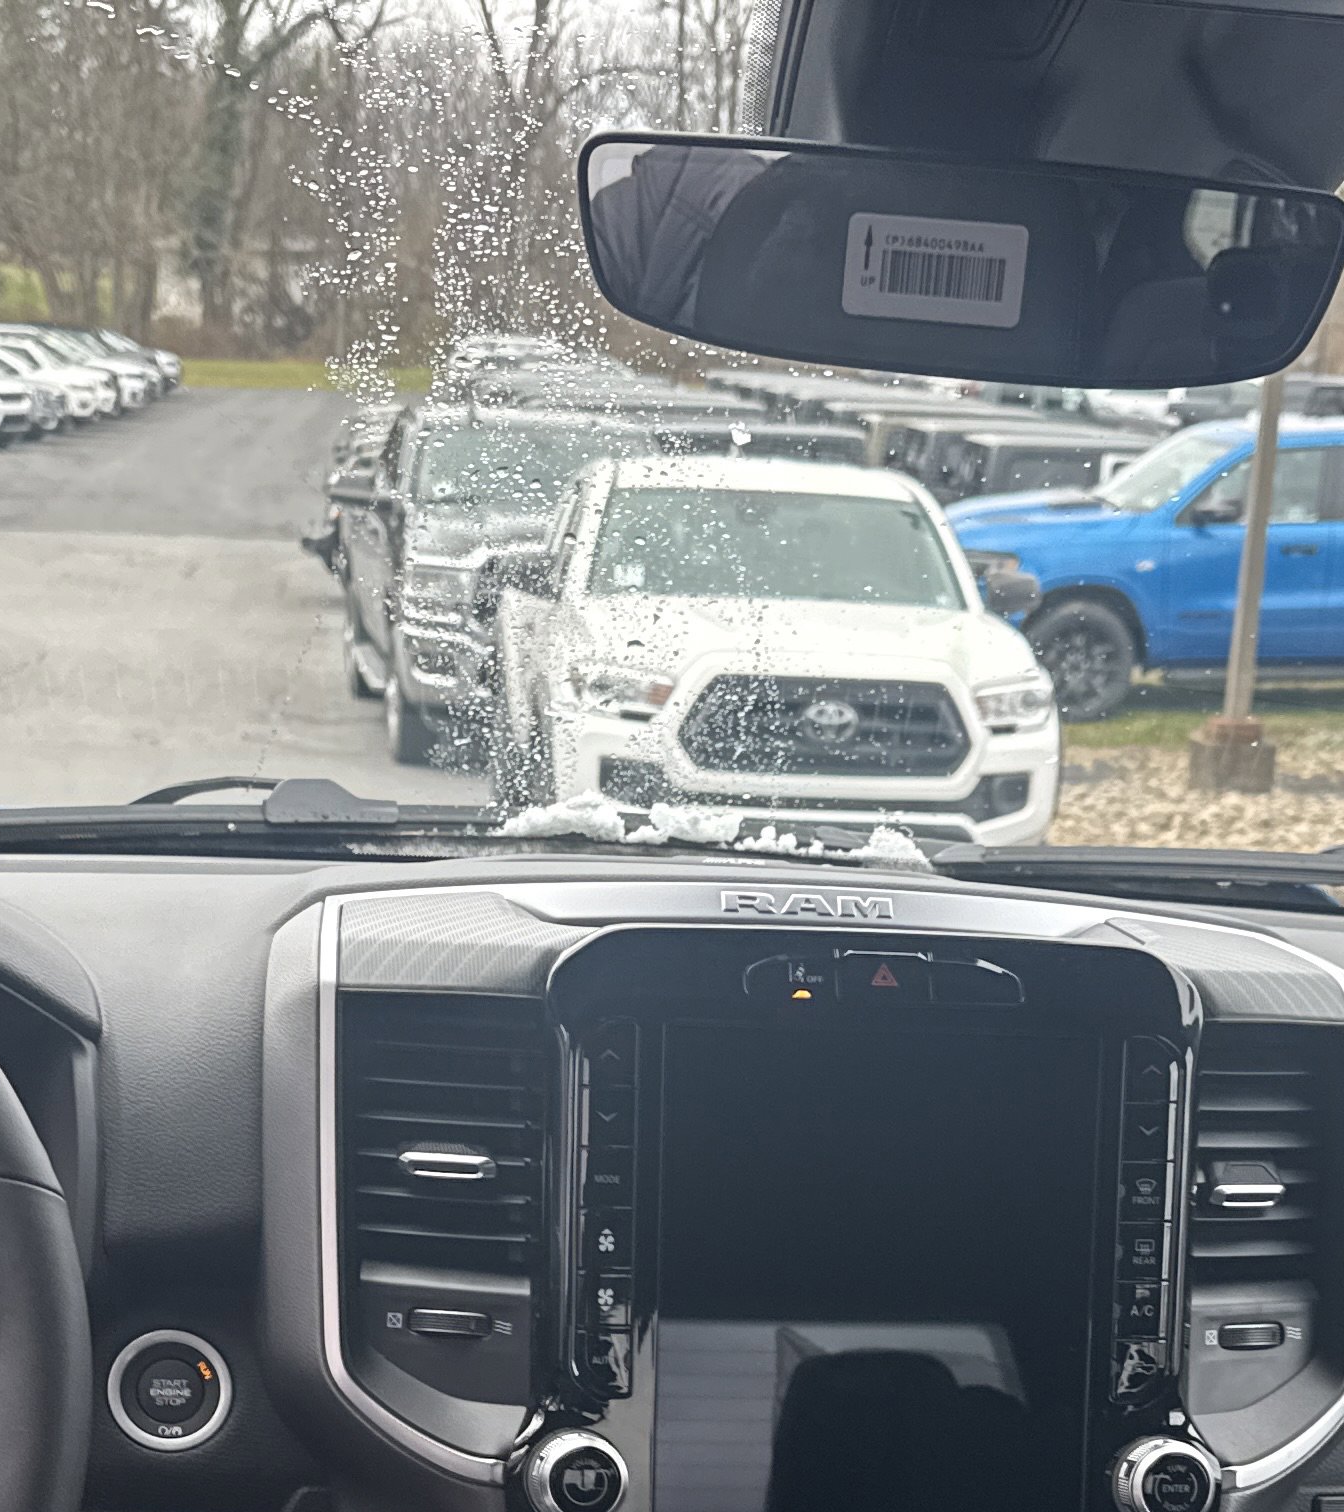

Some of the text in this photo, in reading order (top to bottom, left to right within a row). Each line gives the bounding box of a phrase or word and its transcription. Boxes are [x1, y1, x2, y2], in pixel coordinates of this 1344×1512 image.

[860, 275, 876, 287] UP
[720, 890, 894, 919] RAM
[594, 1174, 621, 1185] MODE
[1131, 1196, 1160, 1206] FRONT
[1132, 1256, 1156, 1265] REAR
[1129, 1304, 1155, 1317] A/C
[152, 1379, 189, 1389] START
[149, 1388, 193, 1398] ENGINE
[155, 1397, 187, 1407] STOP
[1161, 1483, 1191, 1494] ENTER
